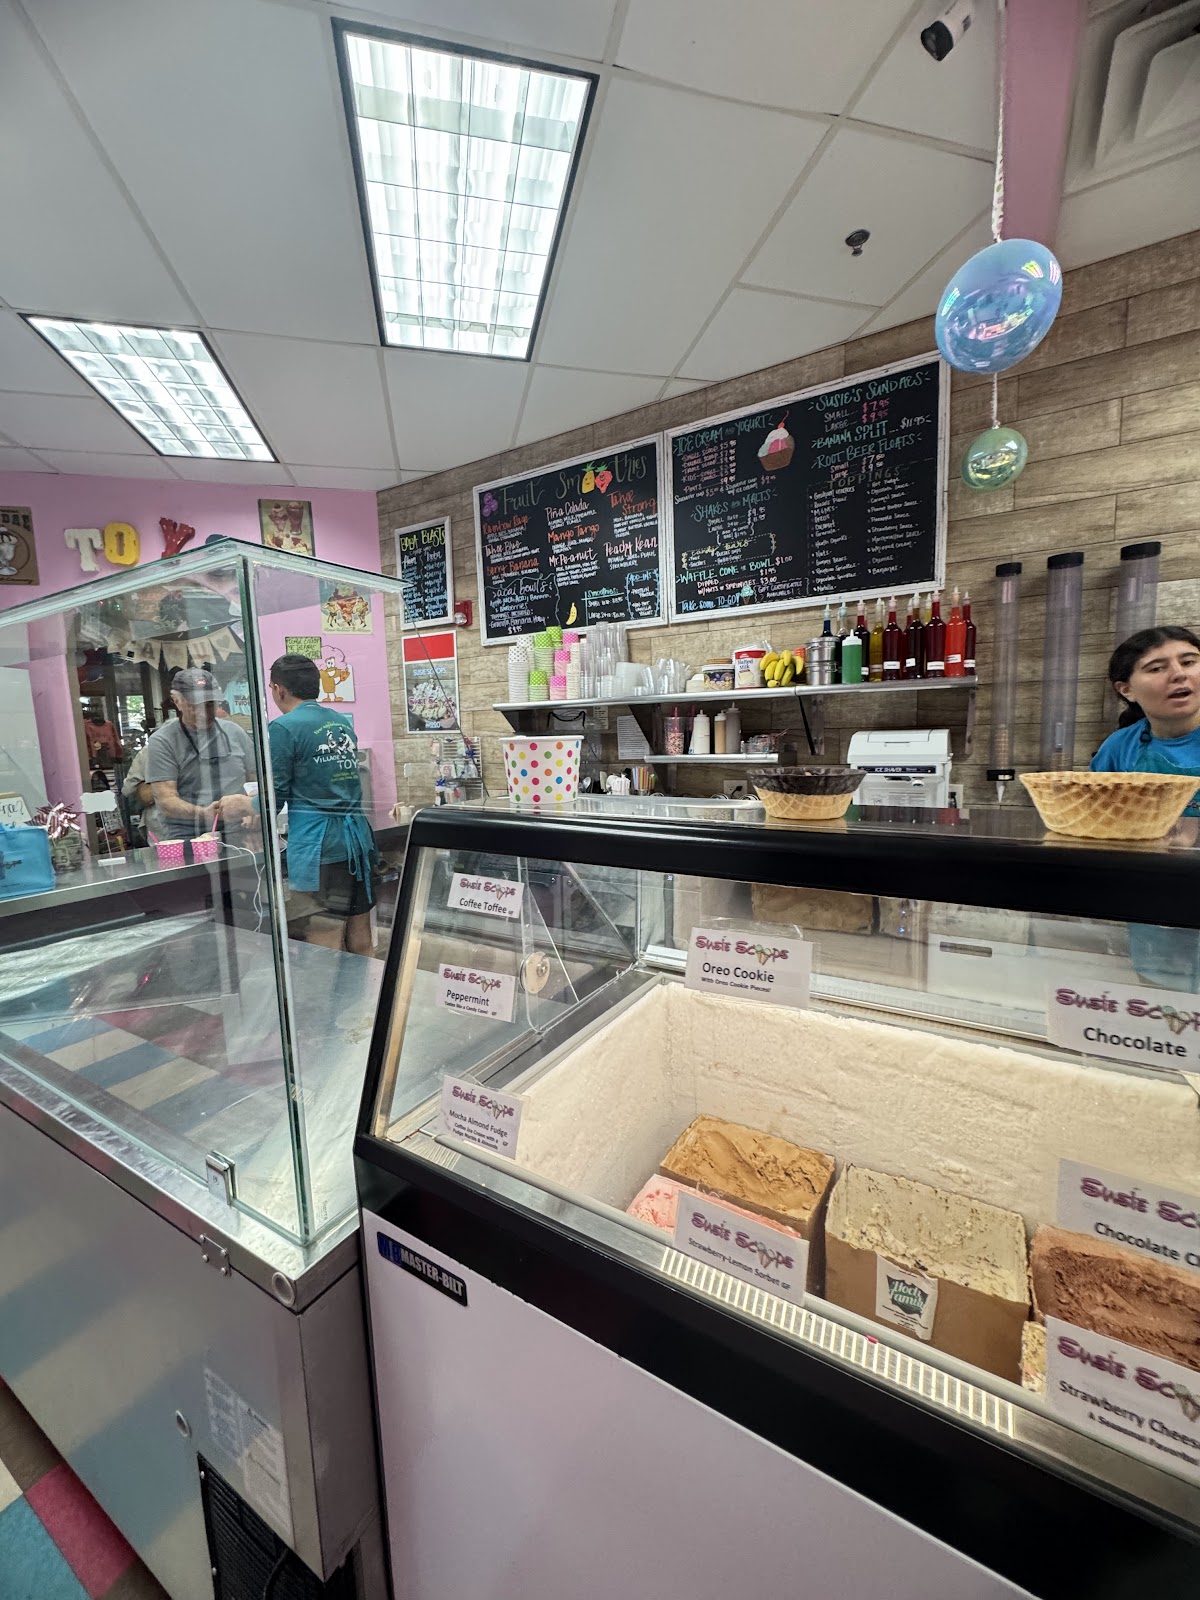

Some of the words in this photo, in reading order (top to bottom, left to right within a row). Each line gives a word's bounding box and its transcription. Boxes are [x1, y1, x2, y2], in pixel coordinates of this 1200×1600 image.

[816, 388, 862, 411] SUSIE'S
[865, 371, 923, 400] SUNDAES
[824, 409, 849, 422] SMALL
[825, 420, 849, 432] LARGE
[676, 437, 694, 456] ICE
[695, 427, 723, 449] CREAM
[735, 413, 770, 435] YOGURT
[817, 429, 851, 448] BANANA
[854, 420, 888, 441] SPLIT
[817, 450, 844, 469] ROOT
[846, 443, 875, 461] BEER
[878, 433, 914, 454] FLOATS
[826, 465, 900, 489] TOPPINGS
[500, 477, 545, 515] Fruit
[565, 498, 590, 515] Colada
[622, 498, 657, 515] Strong
[694, 501, 728, 522] SHAKES
[742, 489, 771, 509] MALTS
[64, 517, 228, 571] TOY
[548, 530, 574, 543] Mango
[574, 524, 600, 540] Tango
[509, 558, 539, 572] Banana
[559, 548, 598, 565] Peanut
[679, 568, 718, 584] WAFFLE
[719, 565, 739, 577] CONE
[749, 559, 774, 571] BOWL
[313, 755, 339, 764] VILLAGE
[337, 759, 359, 769] TOY
[459, 898, 481, 909] Coffee
[483, 901, 507, 913] Toffee
[696, 936, 731, 952] Susie
[702, 962, 730, 976] Oreo
[733, 966, 775, 983] Cookie
[730, 981, 749, 989] Cookie
[447, 989, 490, 1006] Peppermint
[1056, 988, 1119, 1013] Susie
[1083, 1027, 1187, 1057] Chocolate
[449, 1109, 466, 1122] Mocha
[468, 1117, 489, 1131] Almond
[490, 1125, 507, 1138] Fudge
[1081, 1177, 1150, 1213] Susie
[691, 1212, 731, 1241] Susie
[1094, 1221, 1180, 1260] Chocolate
[1184, 1252, 1200, 1268] C
[400, 1248, 463, 1296] MASTER-BILT
[688, 1237, 753, 1273] Strawberry-Lemon
[754, 1268, 780, 1286] Sorbet
[1057, 1336, 1128, 1379] Susie
[1059, 1380, 1146, 1428] Strawberry
